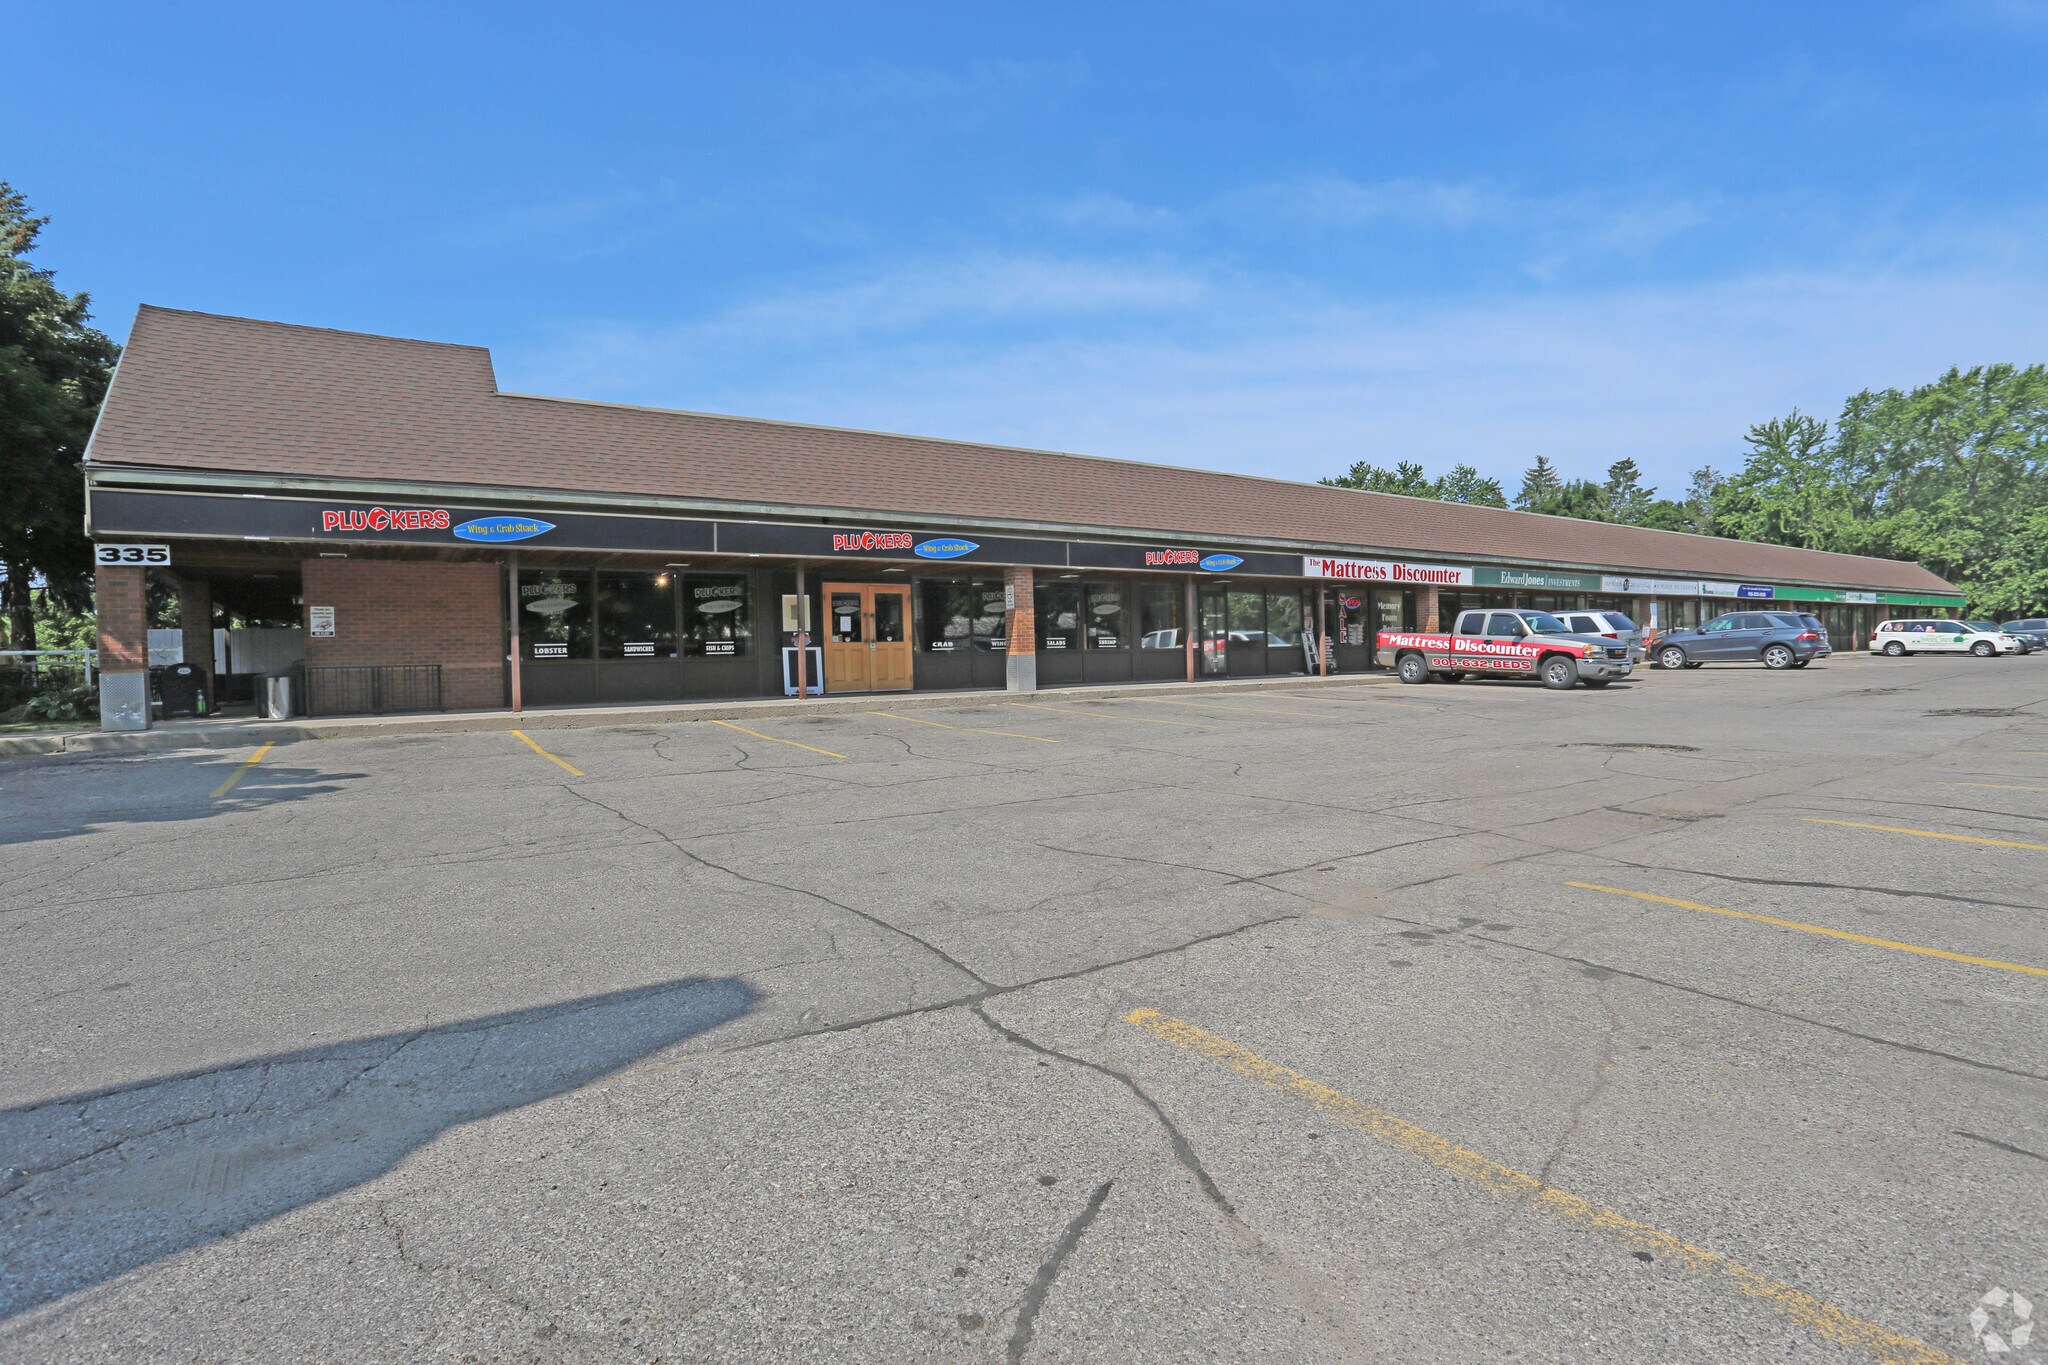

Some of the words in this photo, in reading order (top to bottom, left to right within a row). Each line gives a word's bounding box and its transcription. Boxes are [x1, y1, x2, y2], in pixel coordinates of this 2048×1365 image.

[322, 507, 450, 531] PLUCKERS
[467, 525, 488, 534] Wing
[496, 524, 515, 533] Crab
[515, 523, 539, 533] Shack
[833, 531, 912, 550] PLUCKERS
[98, 547, 168, 563] 335
[1145, 549, 1199, 565] PLUCKERS
[1309, 558, 1320, 567] The
[1322, 559, 1387, 579] Mattress
[1392, 563, 1461, 583] Discounter
[1377, 601, 1400, 611] Memory
[1381, 613, 1398, 622] Foam
[1389, 634, 1450, 650] Mattress
[1454, 639, 1540, 657] Discounter
[1432, 658, 1532, 669] 905-632-BEDS
